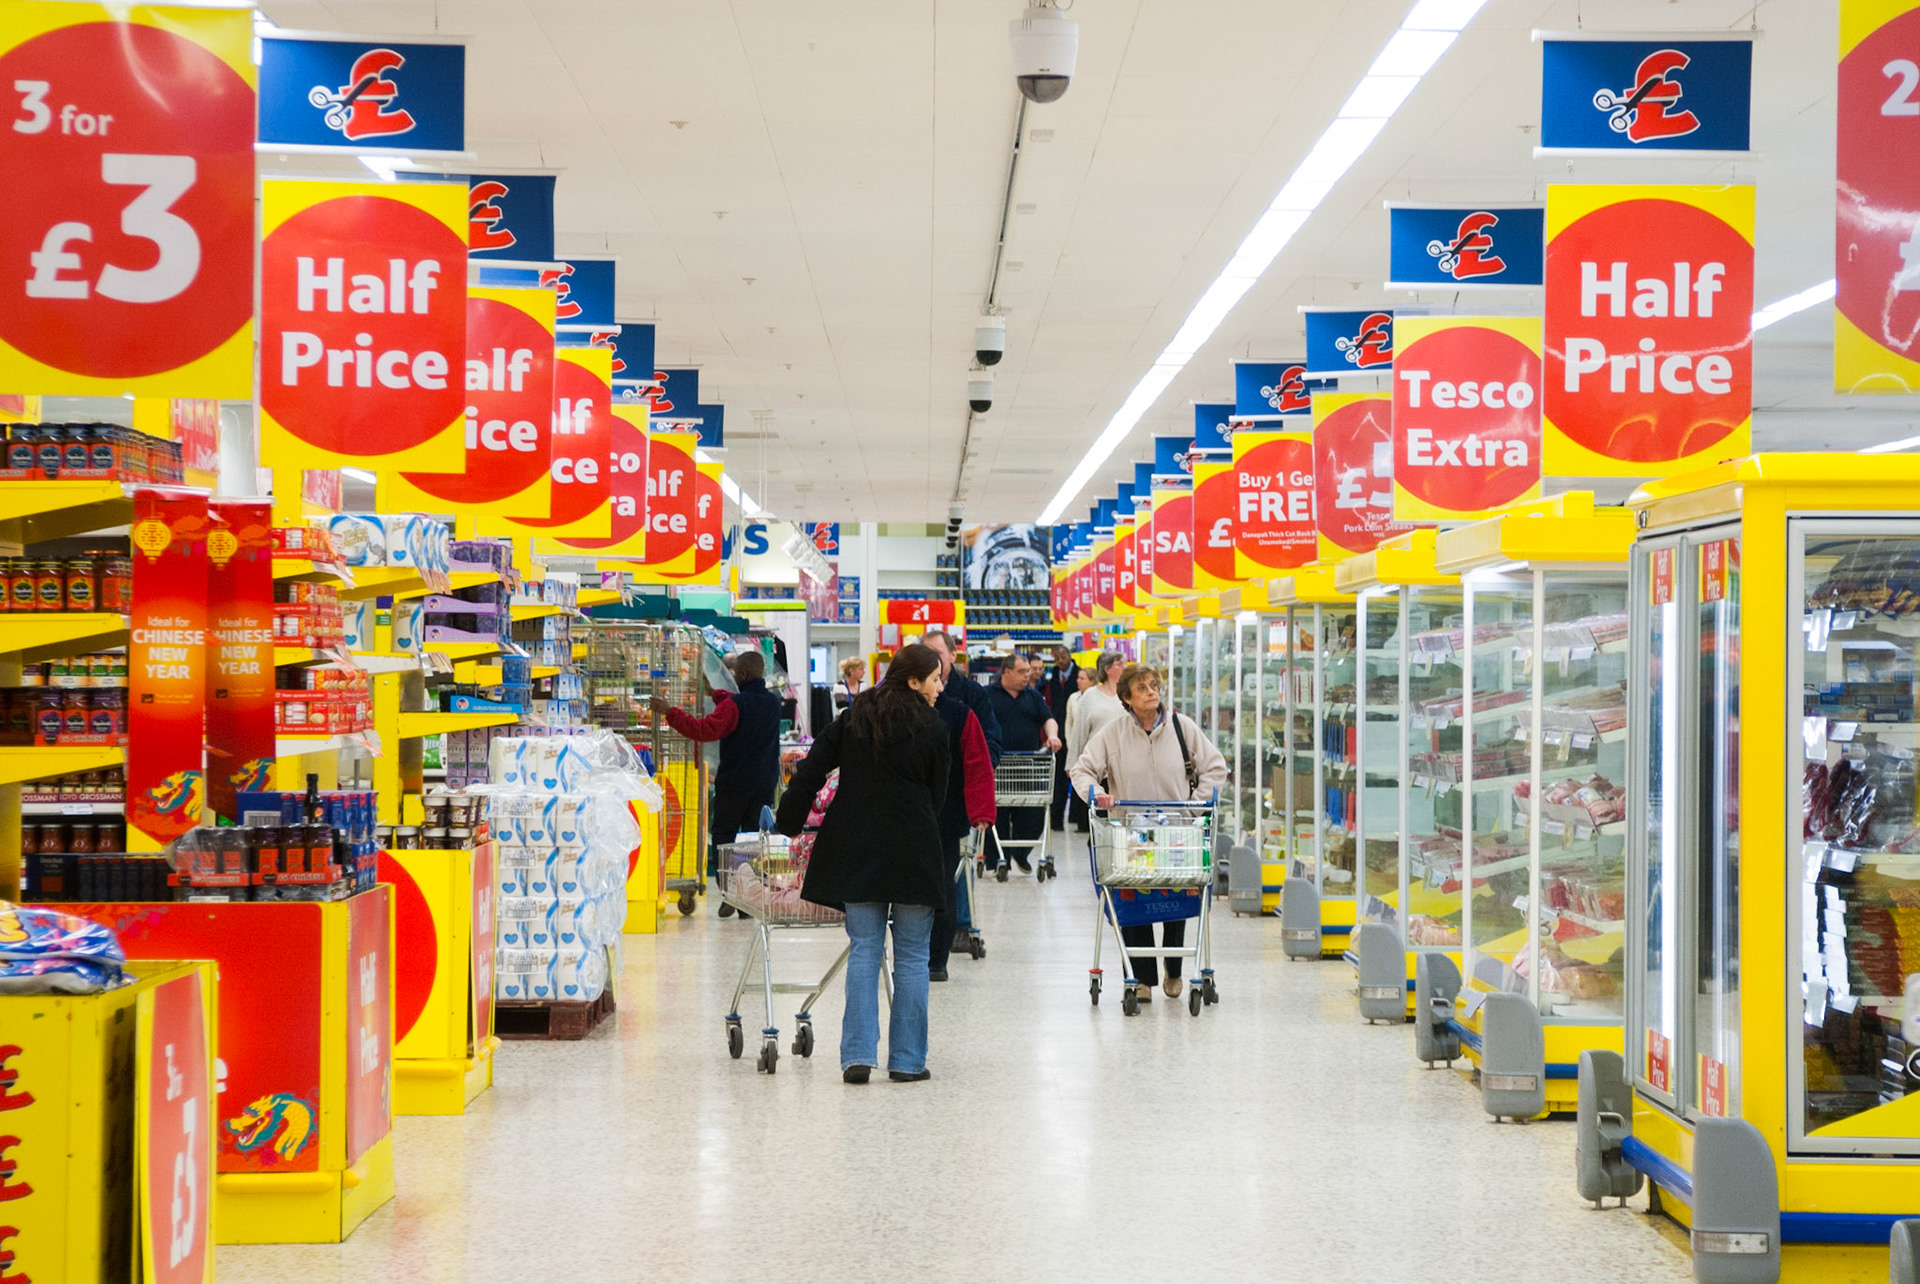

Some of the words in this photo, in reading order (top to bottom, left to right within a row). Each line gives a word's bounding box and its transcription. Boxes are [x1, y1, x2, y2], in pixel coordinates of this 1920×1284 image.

[13, 80, 52, 134] 3
[60, 105, 114, 136] for
[26, 154, 201, 303] £3
[296, 257, 440, 315] Half
[1581, 262, 1726, 318] Half
[281, 331, 448, 389] Price
[465, 348, 533, 392] alf
[1565, 338, 1733, 394] Price
[1400, 370, 1534, 409] Tesco
[465, 406, 538, 451] ice
[1407, 429, 1529, 467] Extra
[647, 470, 683, 496] alf
[1239, 472, 1271, 490] Buy
[1276, 472, 1284, 487] 1
[1290, 470, 1314, 486] Ge
[1344, 524, 1363, 533] Pork
[1155, 531, 1193, 553] SA
[147, 616, 172, 627] Ideal
[175, 616, 190, 627] for
[219, 618, 242, 627] Ideal
[244, 617, 258, 626] for
[912, 604, 929, 620] £1
[132, 629, 205, 645] CHINESE
[213, 629, 273, 643] HINESE
[148, 647, 188, 662] NEW
[220, 646, 257, 659] NEW
[145, 664, 190, 679] YEAR
[218, 662, 260, 675] YEAR
[22, 794, 56, 802] OSSMAN
[79, 793, 122, 801] GROSSMAN
